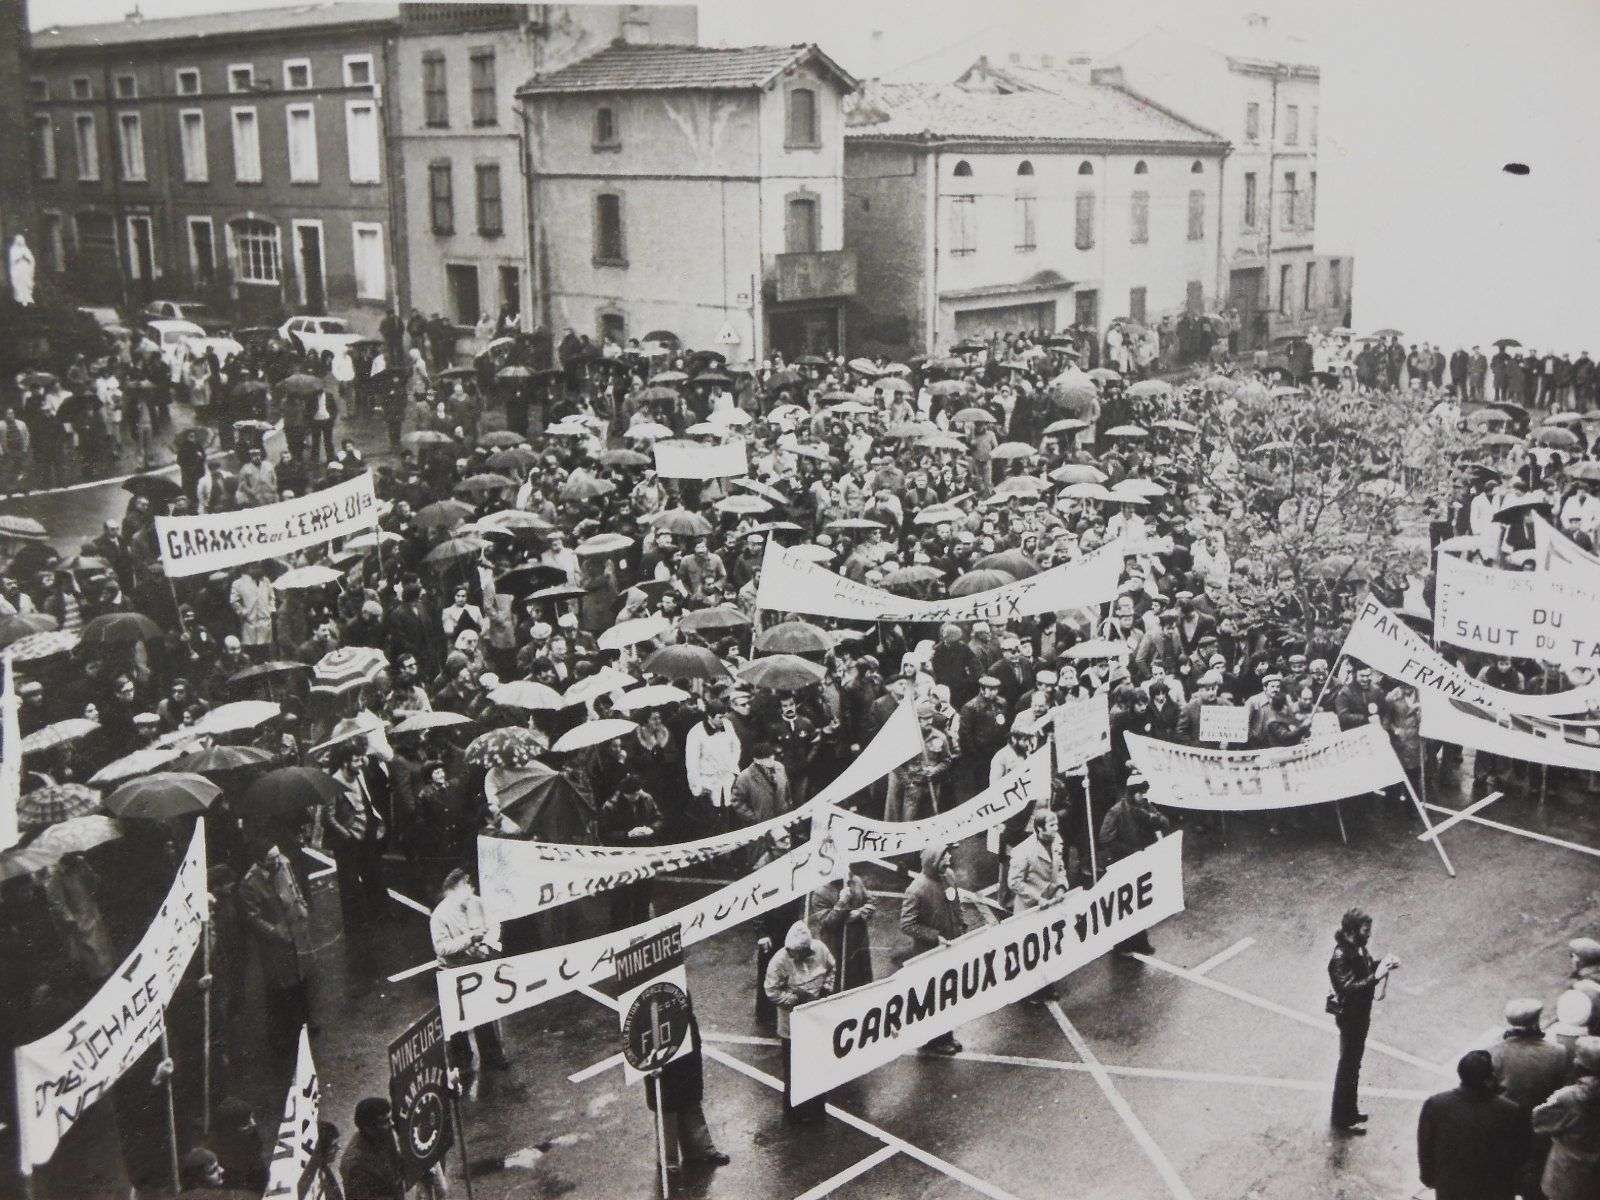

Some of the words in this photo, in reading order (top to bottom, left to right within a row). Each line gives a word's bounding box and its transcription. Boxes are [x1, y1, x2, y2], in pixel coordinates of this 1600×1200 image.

[167, 524, 267, 560] GARANTIE
[1456, 620, 1519, 646] SAUT
[1536, 635, 1556, 650] DU
[1532, 608, 1562, 628] DU
[616, 932, 682, 981] MINEURS
[832, 949, 997, 1058] CARMAUX
[1005, 919, 1067, 981] DOIT
[1073, 871, 1154, 942] VIVRE
[391, 1016, 444, 1077] MINEURS
